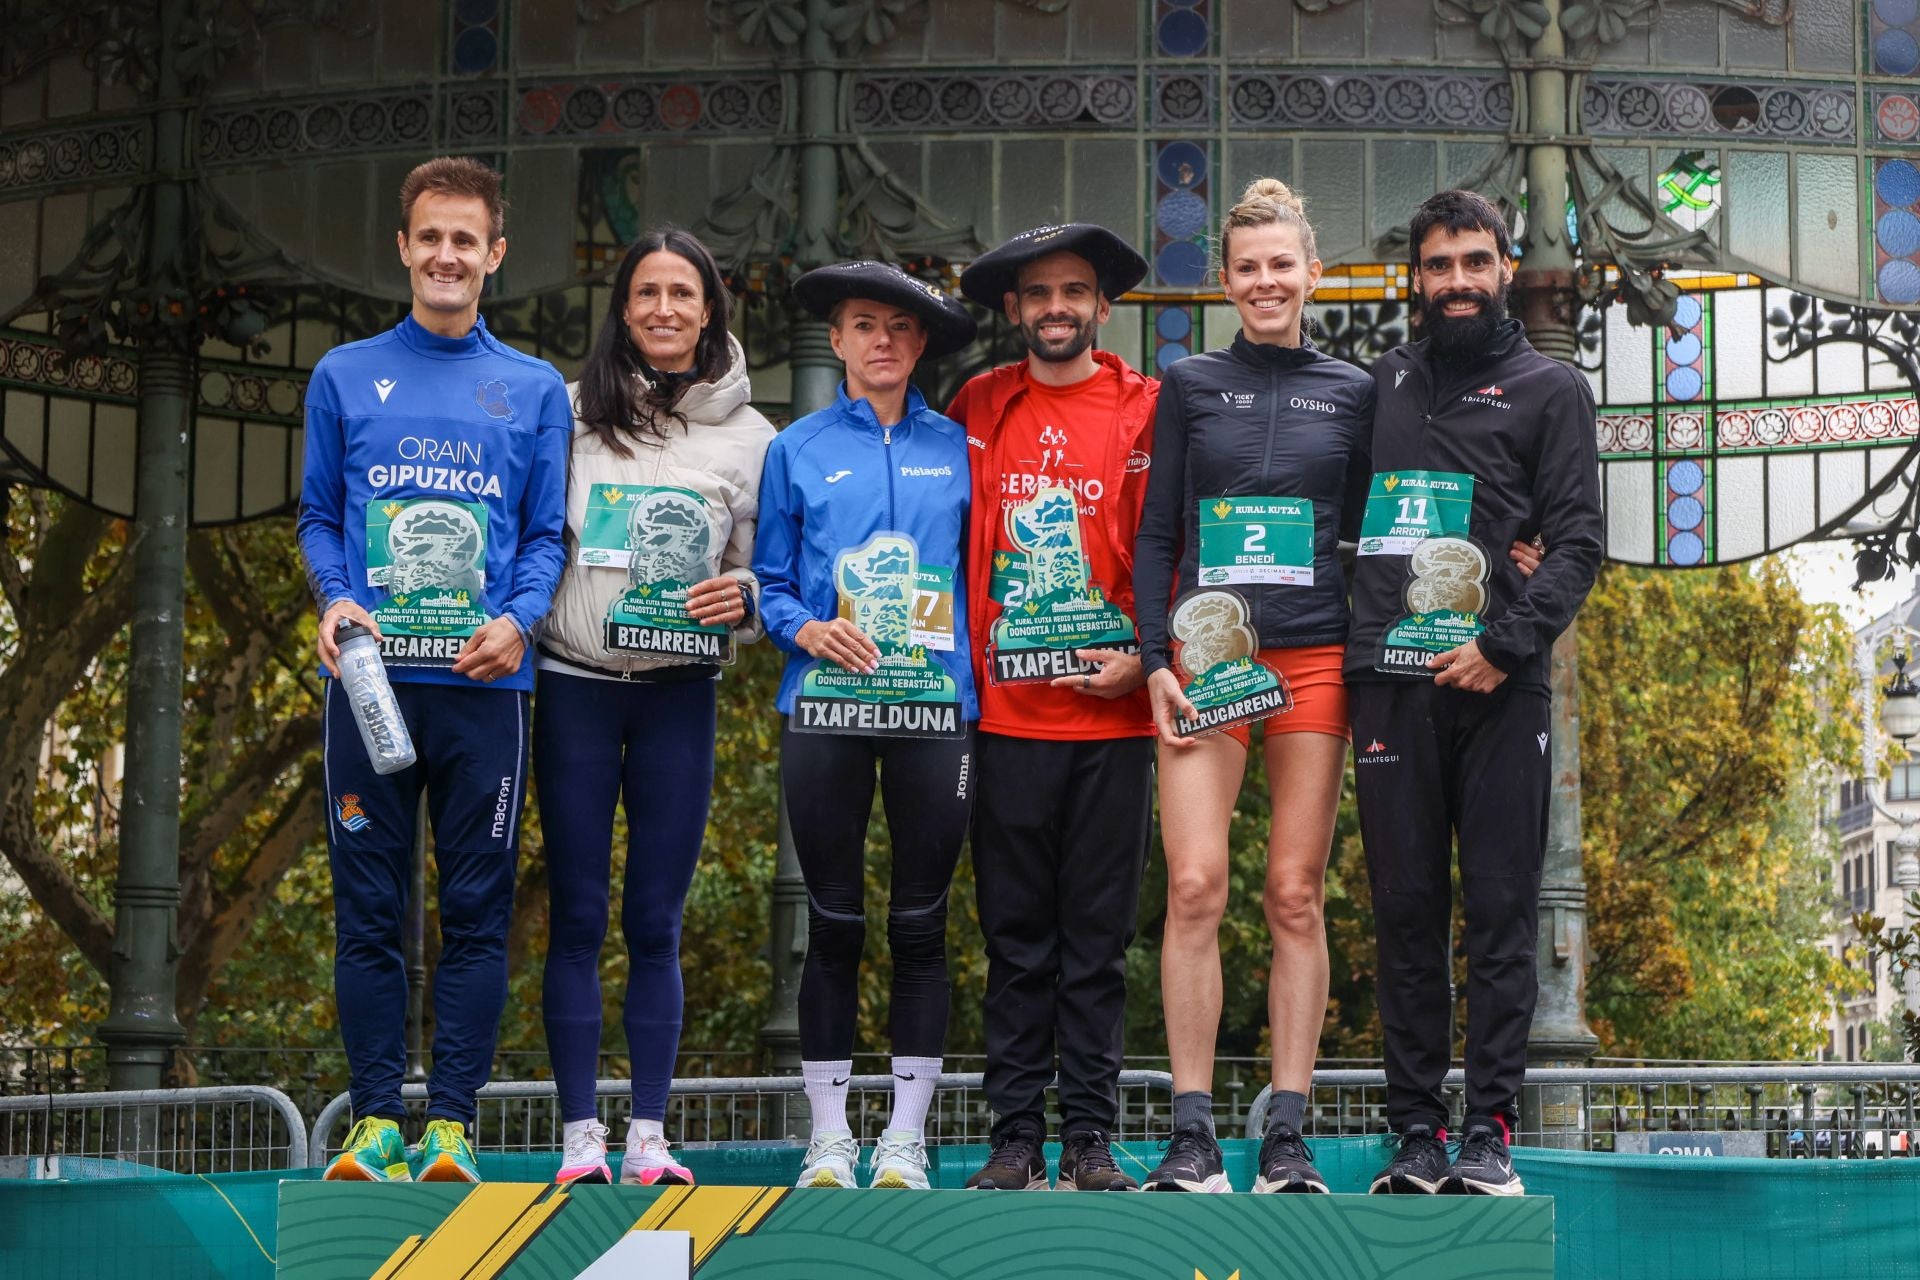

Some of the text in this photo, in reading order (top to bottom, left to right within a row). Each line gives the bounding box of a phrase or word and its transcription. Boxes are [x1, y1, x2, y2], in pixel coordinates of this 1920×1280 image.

[1290, 397, 1336, 414] OYSHO
[398, 436, 481, 466] ORAIN
[368, 464, 502, 498] GIPUZKOA
[1400, 479, 1460, 491] RURAL KUTXA
[1235, 506, 1301, 515] RURAL KUTXA
[1394, 497, 1429, 525] 11
[1243, 524, 1266, 552] 2
[1389, 526, 1430, 537] ARROYO
[1235, 553, 1275, 564] BENEDÍ
[377, 614, 415, 623] DONOSTIA
[423, 616, 438, 624] SAN
[440, 614, 482, 625] SEBASTIÁN
[624, 604, 657, 615] DONOSTIA
[663, 609, 677, 618] SAN
[1009, 625, 1050, 637] DONOSTIA
[1058, 624, 1075, 633] SAN
[1076, 618, 1120, 632] SEBASTIÁN
[1397, 630, 1429, 640] DONOSTIA
[1435, 633, 1449, 641] SAN
[618, 626, 720, 656] BIGARRENA
[817, 675, 862, 686] DONOSTIA
[871, 679, 889, 688] SAN
[893, 677, 942, 690] SEBASTIÁN
[1220, 686, 1232, 694] SAN
[1233, 674, 1266, 690] SEBASTIÁN
[800, 702, 956, 732] TXAPELDUNA
[1179, 690, 1283, 734] HIRUGARRENA
[956, 753, 970, 800] Joma
[491, 776, 511, 838] macron
